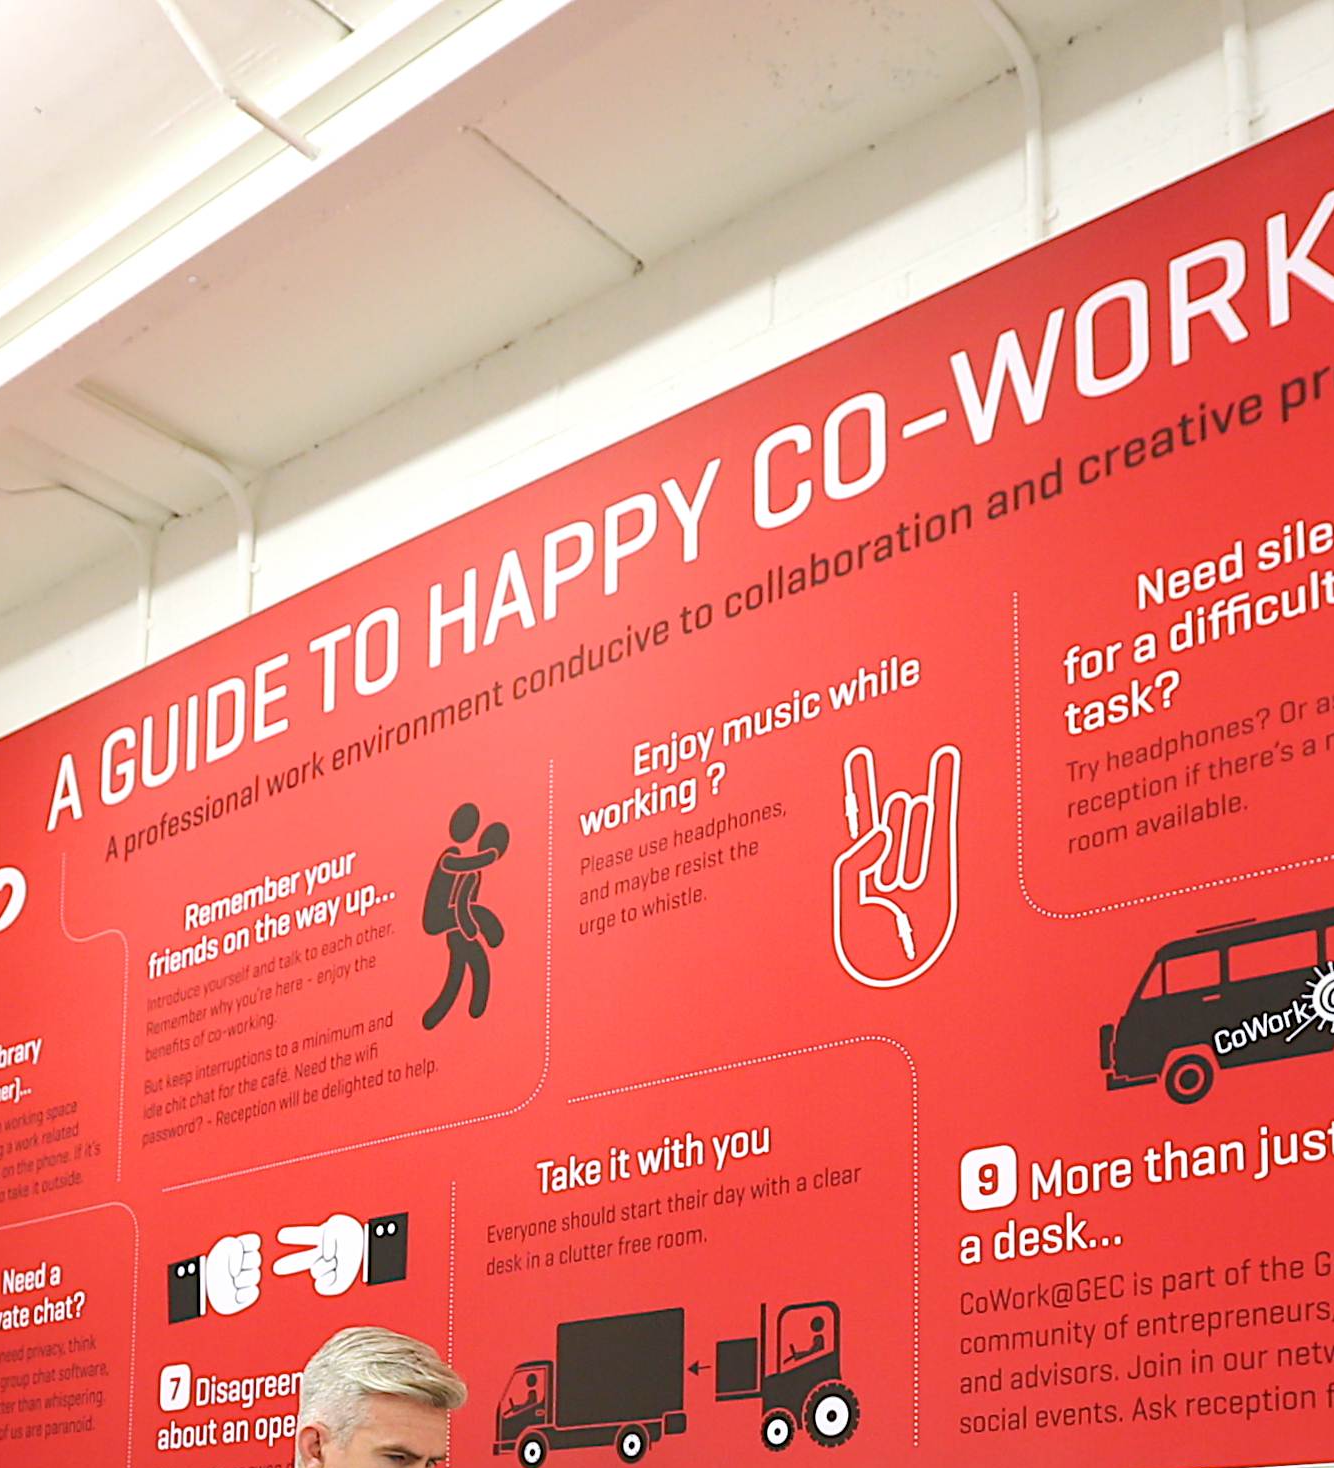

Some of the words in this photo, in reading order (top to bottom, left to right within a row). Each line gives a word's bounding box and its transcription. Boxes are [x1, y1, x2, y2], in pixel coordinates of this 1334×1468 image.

[1139, 541, 1242, 609] Need
[47, 753, 83, 831] A
[99, 653, 289, 806] GUIDE
[309, 606, 400, 714] TO
[429, 458, 721, 668] HAPPY
[106, 836, 118, 862] A
[125, 775, 259, 862] professional
[267, 752, 324, 796] work
[332, 682, 503, 771] environment
[513, 620, 669, 699] conducive
[680, 604, 712, 634] to
[725, 504, 971, 618] collaboration
[987, 458, 1062, 520] and
[1079, 394, 1262, 485] creative
[1064, 643, 1121, 684] for
[1134, 634, 1155, 662] a
[635, 728, 714, 775] Enjoy
[724, 691, 820, 746] music
[829, 657, 919, 709] while
[1065, 671, 1179, 734] task?
[1066, 760, 1099, 782] Try
[1107, 708, 1270, 771] headphones?
[1280, 701, 1307, 723] Or
[581, 779, 696, 835] working
[707, 763, 725, 794] ?
[1068, 776, 1177, 818] reception
[1186, 763, 1200, 787] if
[1208, 742, 1293, 780] there's
[1303, 739, 1316, 756] a
[581, 848, 633, 875] Please
[639, 837, 667, 857] use
[674, 803, 786, 847] headphones,
[1069, 825, 1127, 854] room
[1136, 795, 1247, 836] available.
[186, 872, 300, 930] Remember
[305, 853, 356, 895] your
[580, 880, 609, 905] and
[615, 867, 669, 895] maybe
[676, 849, 723, 877] resist
[730, 841, 758, 861] the
[149, 936, 218, 979] friends
[224, 928, 249, 953] on
[255, 914, 290, 942] the
[296, 897, 340, 929] way
[346, 886, 394, 916] up...
[580, 914, 615, 935] urge
[621, 908, 637, 923] to
[642, 887, 706, 917] whistle.
[537, 1156, 600, 1193] Take
[611, 1148, 630, 1180] it
[638, 1133, 703, 1174] with
[713, 1128, 769, 1170] you
[977, 1163, 997, 1195] 9
[1032, 1159, 1131, 1200] More
[1144, 1142, 1244, 1182] than
[488, 1219, 556, 1243] Everyone
[562, 1205, 615, 1231] should
[621, 1199, 662, 1221] start
[667, 1189, 708, 1213] their
[714, 1185, 745, 1207] day
[751, 1176, 789, 1199] with
[797, 1177, 806, 1192] a
[814, 1168, 861, 1189] clear
[961, 1236, 980, 1264] a
[995, 1212, 1120, 1259] desk...
[3, 1262, 46, 1294] Need
[50, 1266, 60, 1285] a
[34, 1292, 85, 1324] chat?
[961, 1275, 1124, 1315] CoWork@GEC
[1134, 1272, 1152, 1296] is
[1163, 1266, 1215, 1299] part
[1225, 1259, 1251, 1286] of
[1259, 1256, 1303, 1282] the
[170, 1377, 181, 1400] 7
[158, 1420, 216, 1450] about
[223, 1421, 248, 1443] an
